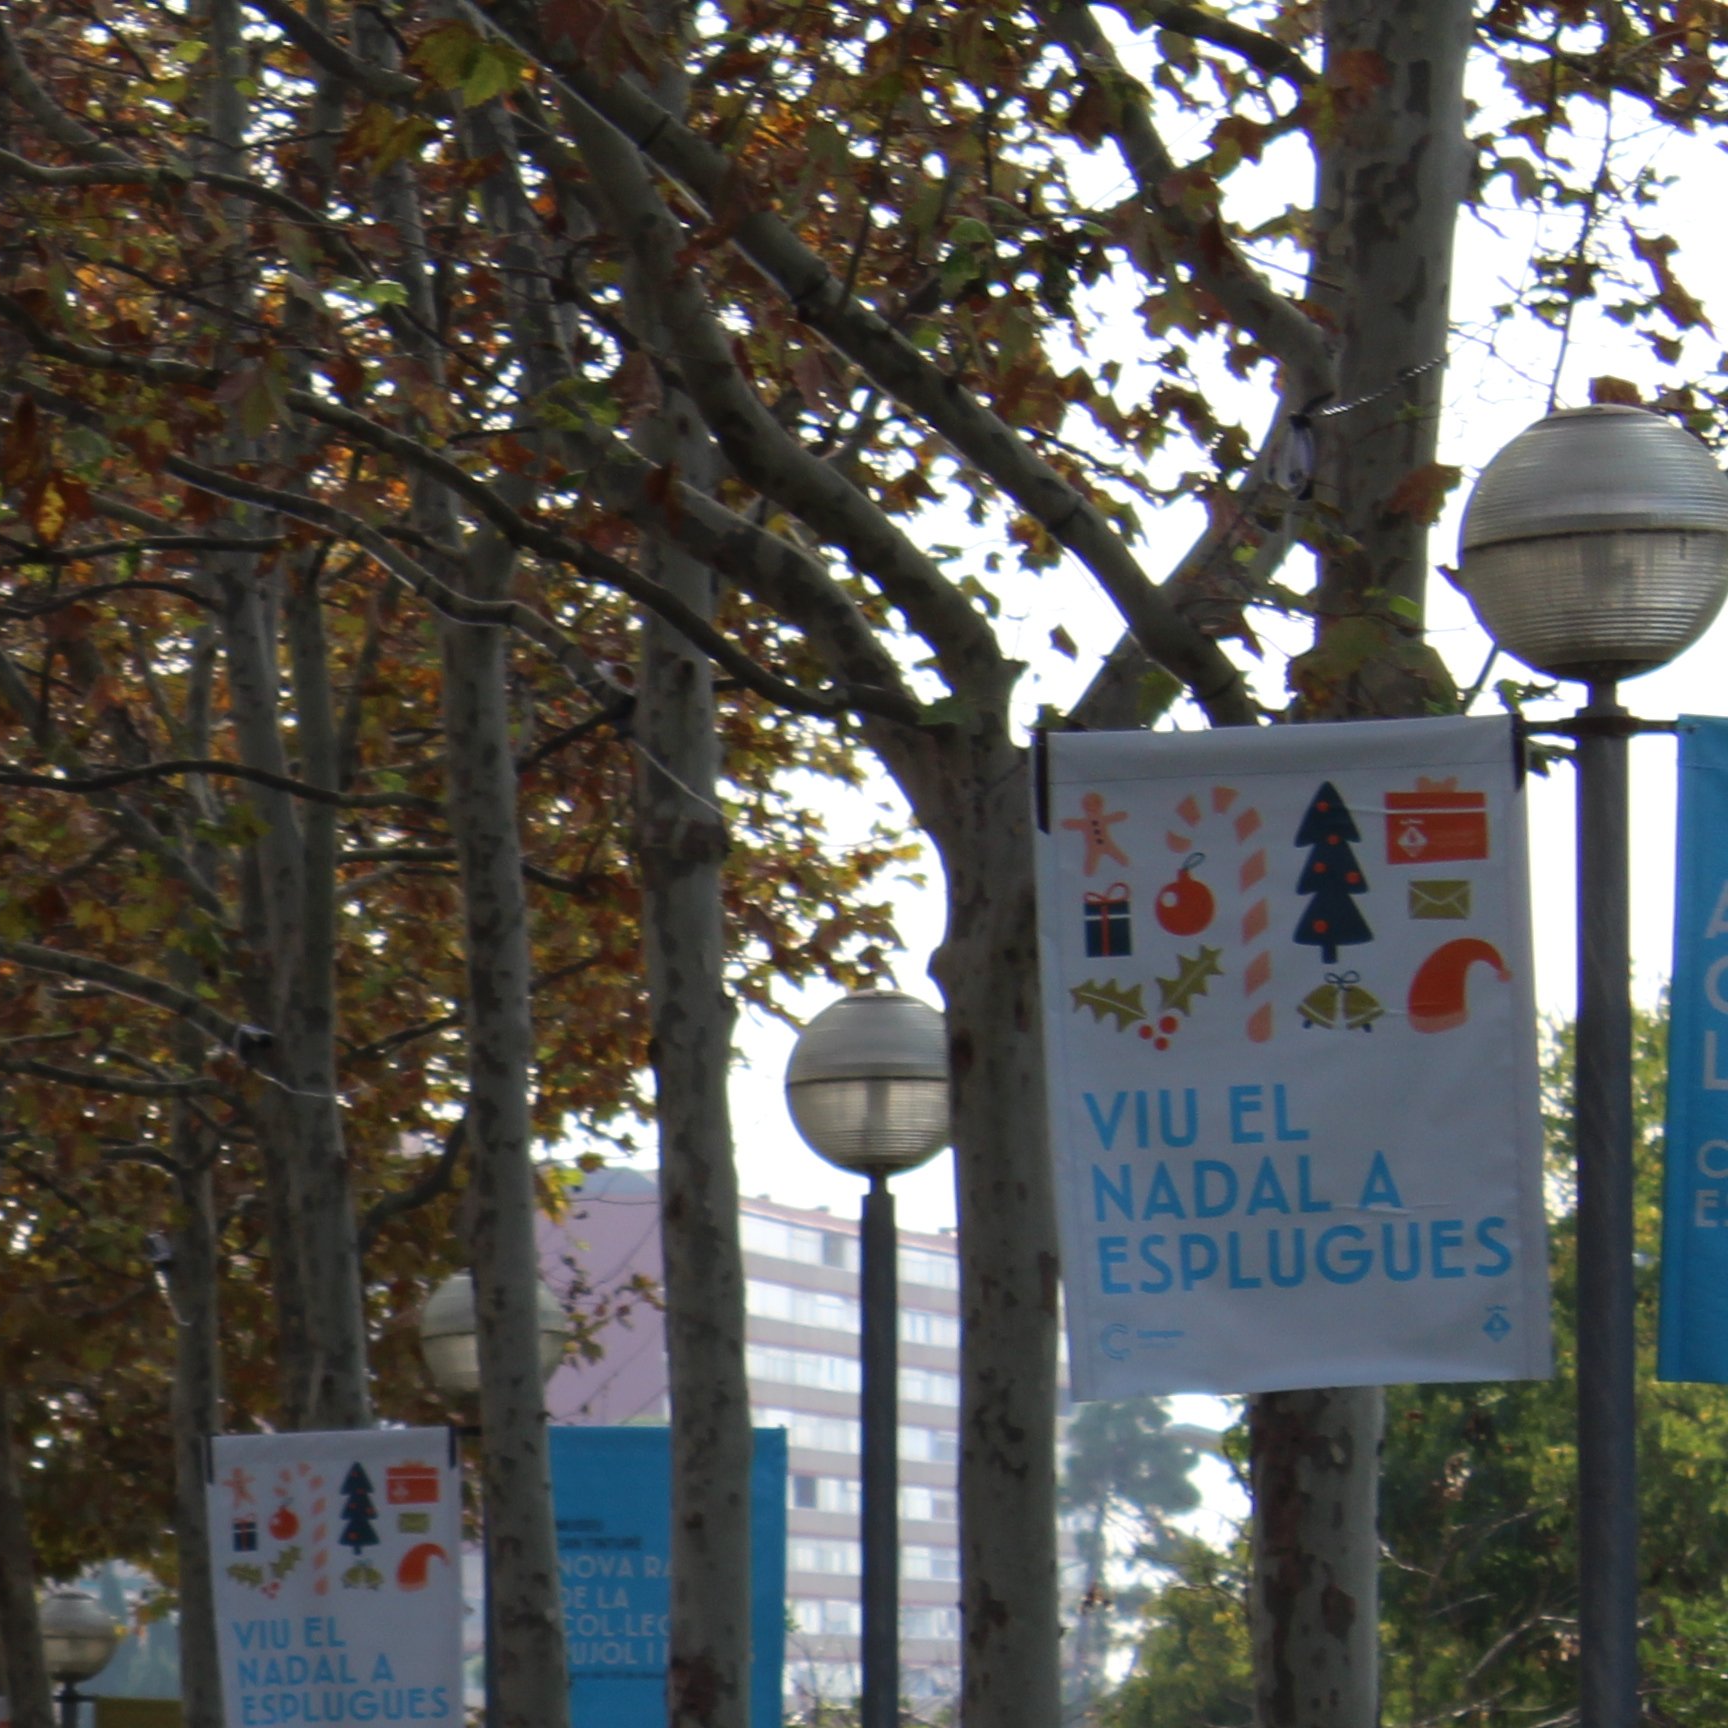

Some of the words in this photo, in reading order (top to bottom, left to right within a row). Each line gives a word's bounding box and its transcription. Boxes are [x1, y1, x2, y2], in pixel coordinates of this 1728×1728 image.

[1083, 1087, 1198, 1150] VIU
[1229, 1084, 1309, 1144] EL
[1093, 1157, 1332, 1222] NADAL
[1359, 1151, 1403, 1209] A
[1097, 1217, 1513, 1295] ESPLUGUES
[558, 1555, 634, 1578] NOVA
[597, 1586, 630, 1610] LA
[232, 1618, 291, 1649] VIU
[304, 1616, 346, 1647] EL
[237, 1653, 357, 1688] NADAL
[371, 1652, 396, 1683] A
[571, 1641, 638, 1665] UJOL
[240, 1686, 450, 1726] ESPLUGUES
